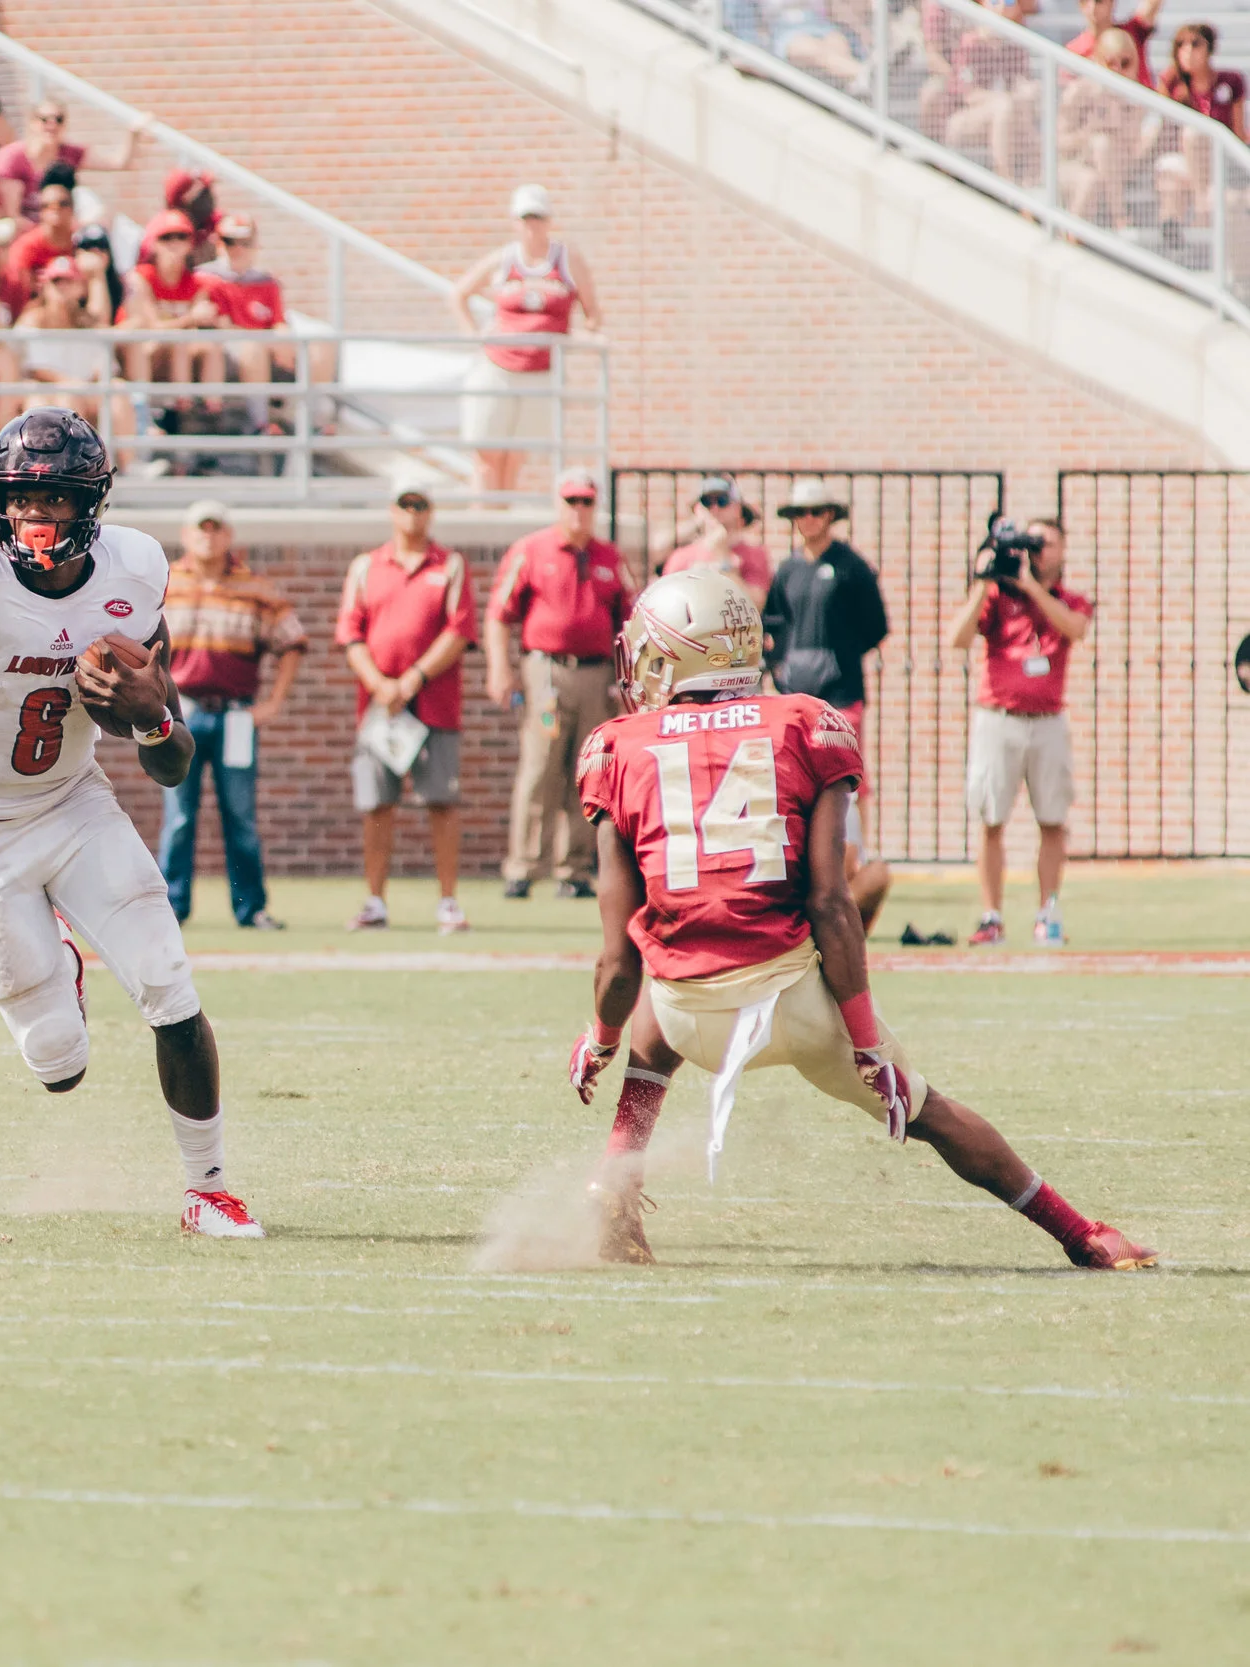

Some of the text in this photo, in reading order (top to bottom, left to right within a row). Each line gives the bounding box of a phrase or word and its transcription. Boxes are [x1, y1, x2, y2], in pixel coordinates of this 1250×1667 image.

[106, 601, 131, 614] ACC
[11, 687, 72, 776] 8
[661, 704, 761, 735] MEYERS
[644, 737, 791, 890] 14
